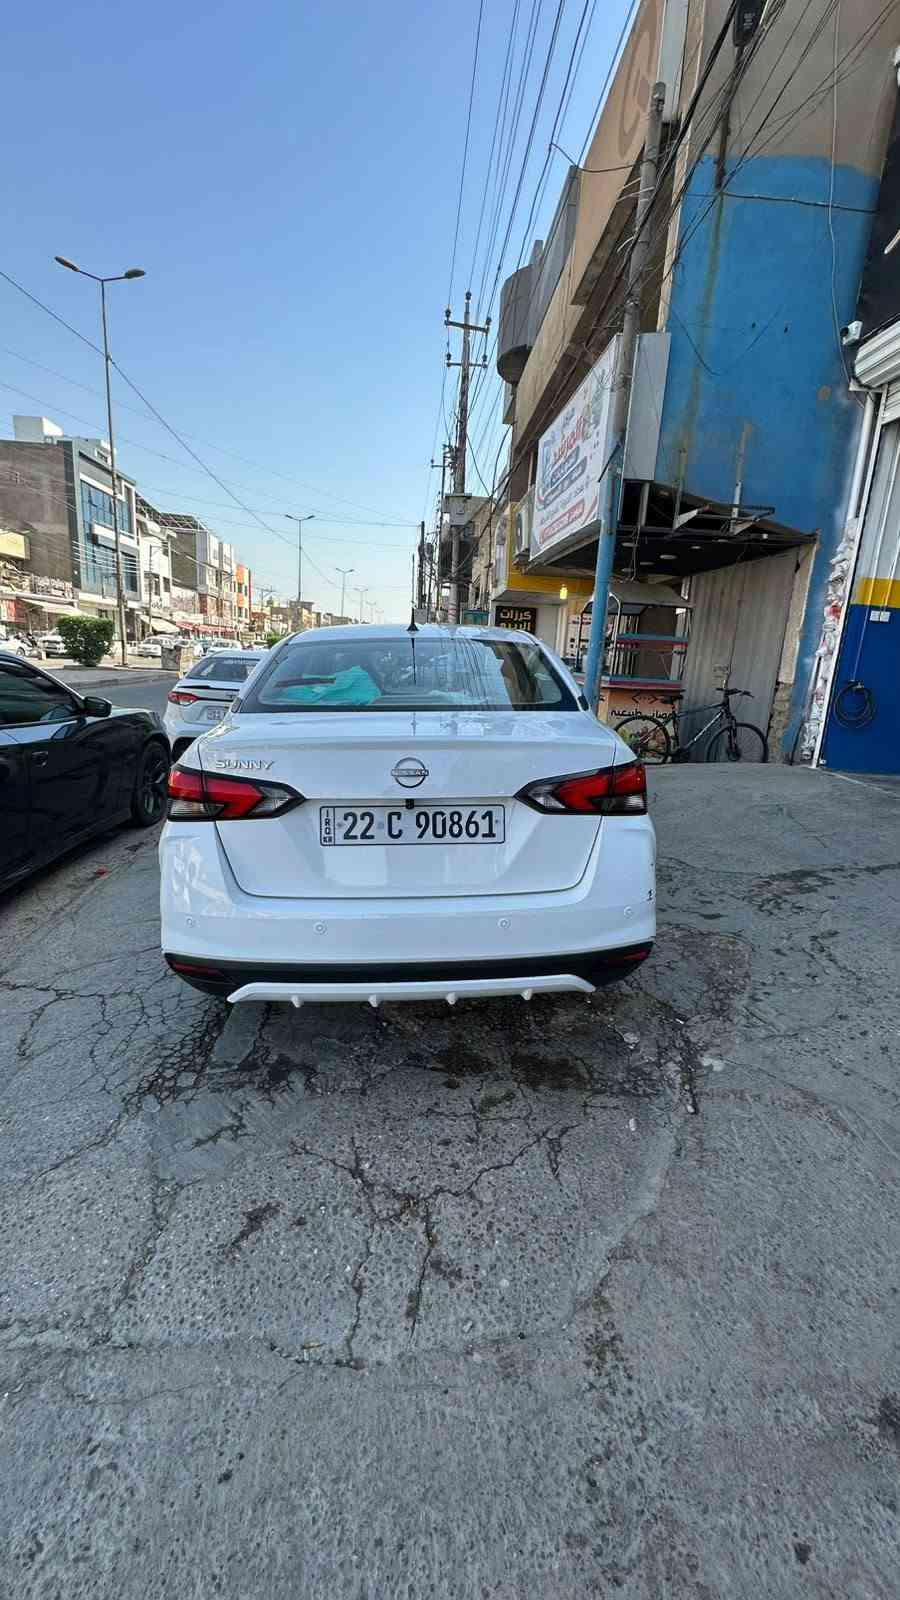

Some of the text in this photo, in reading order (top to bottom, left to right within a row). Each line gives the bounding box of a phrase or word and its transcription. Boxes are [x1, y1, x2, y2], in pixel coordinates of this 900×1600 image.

[500, 609, 532, 621] كرزات
[215, 759, 277, 770] SUNNY
[343, 810, 496, 840] 22 C 90861
